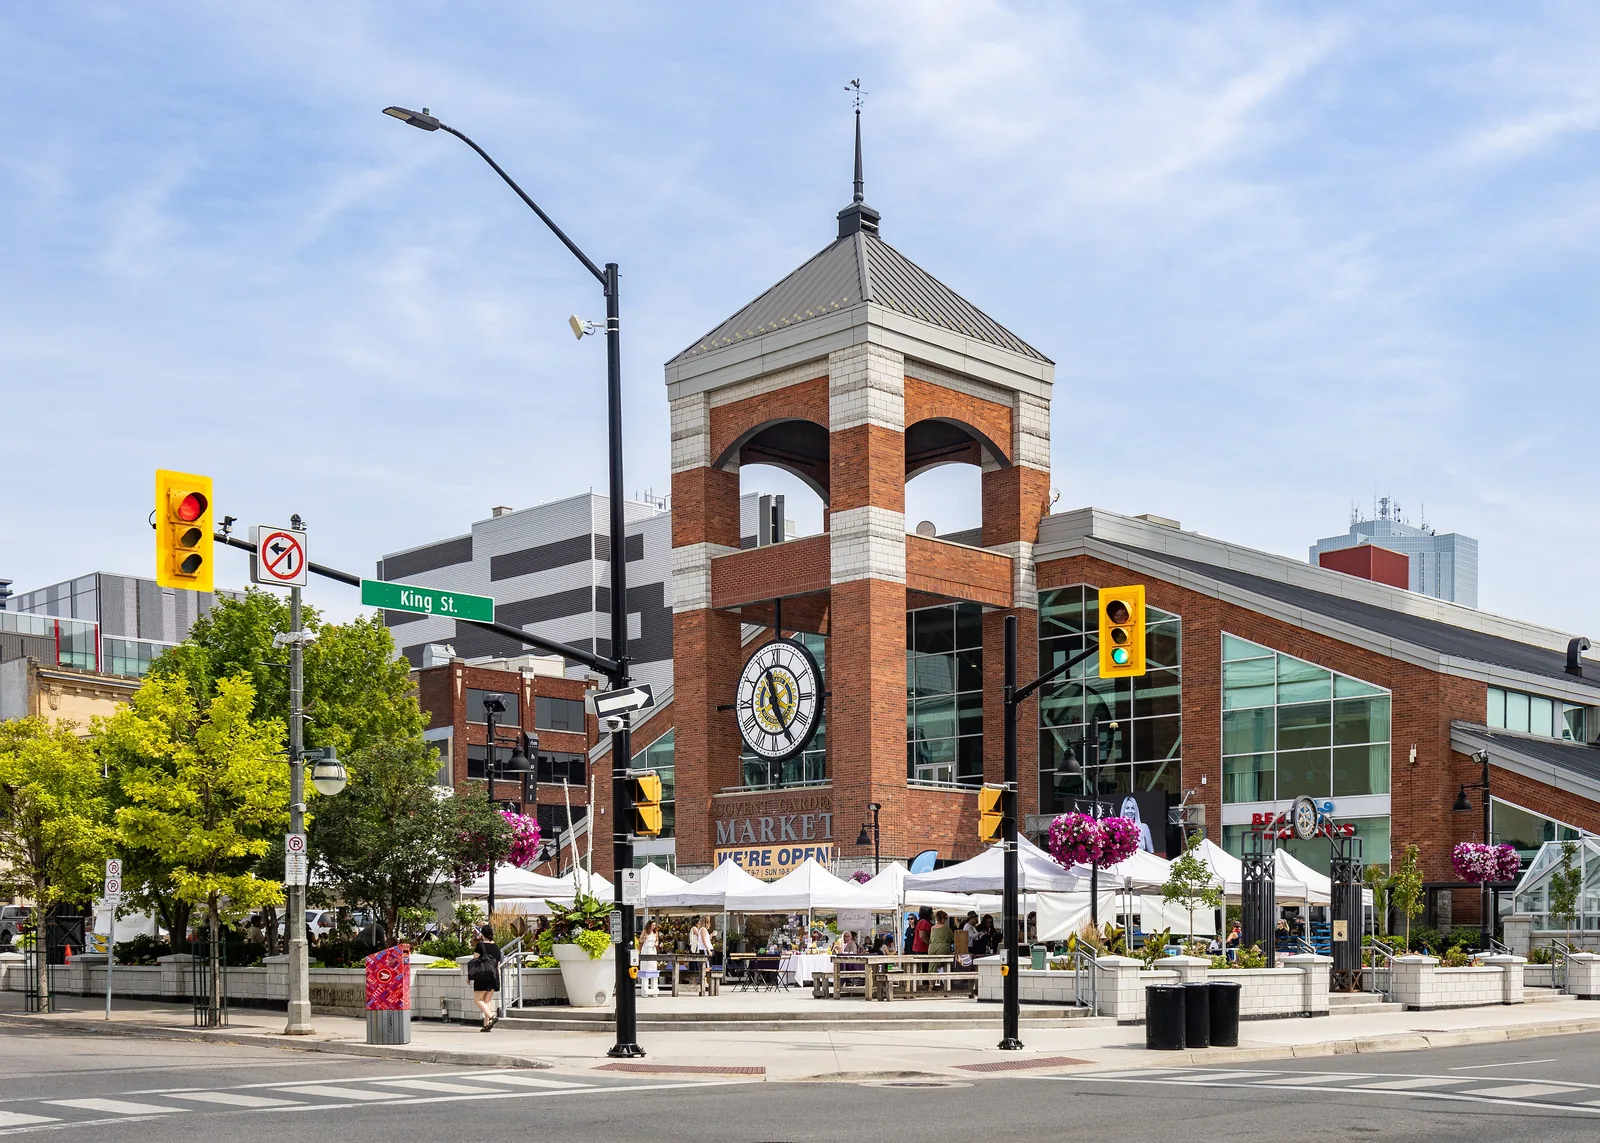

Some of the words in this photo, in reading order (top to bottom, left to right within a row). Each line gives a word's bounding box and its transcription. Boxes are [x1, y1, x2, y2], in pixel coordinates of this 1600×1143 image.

[400, 589, 432, 613] King
[440, 596, 458, 613] St.
[716, 799, 769, 817] COVENT
[715, 813, 834, 845] MARKET
[717, 849, 772, 867] WE'RE
[764, 868, 776, 876] SUN
